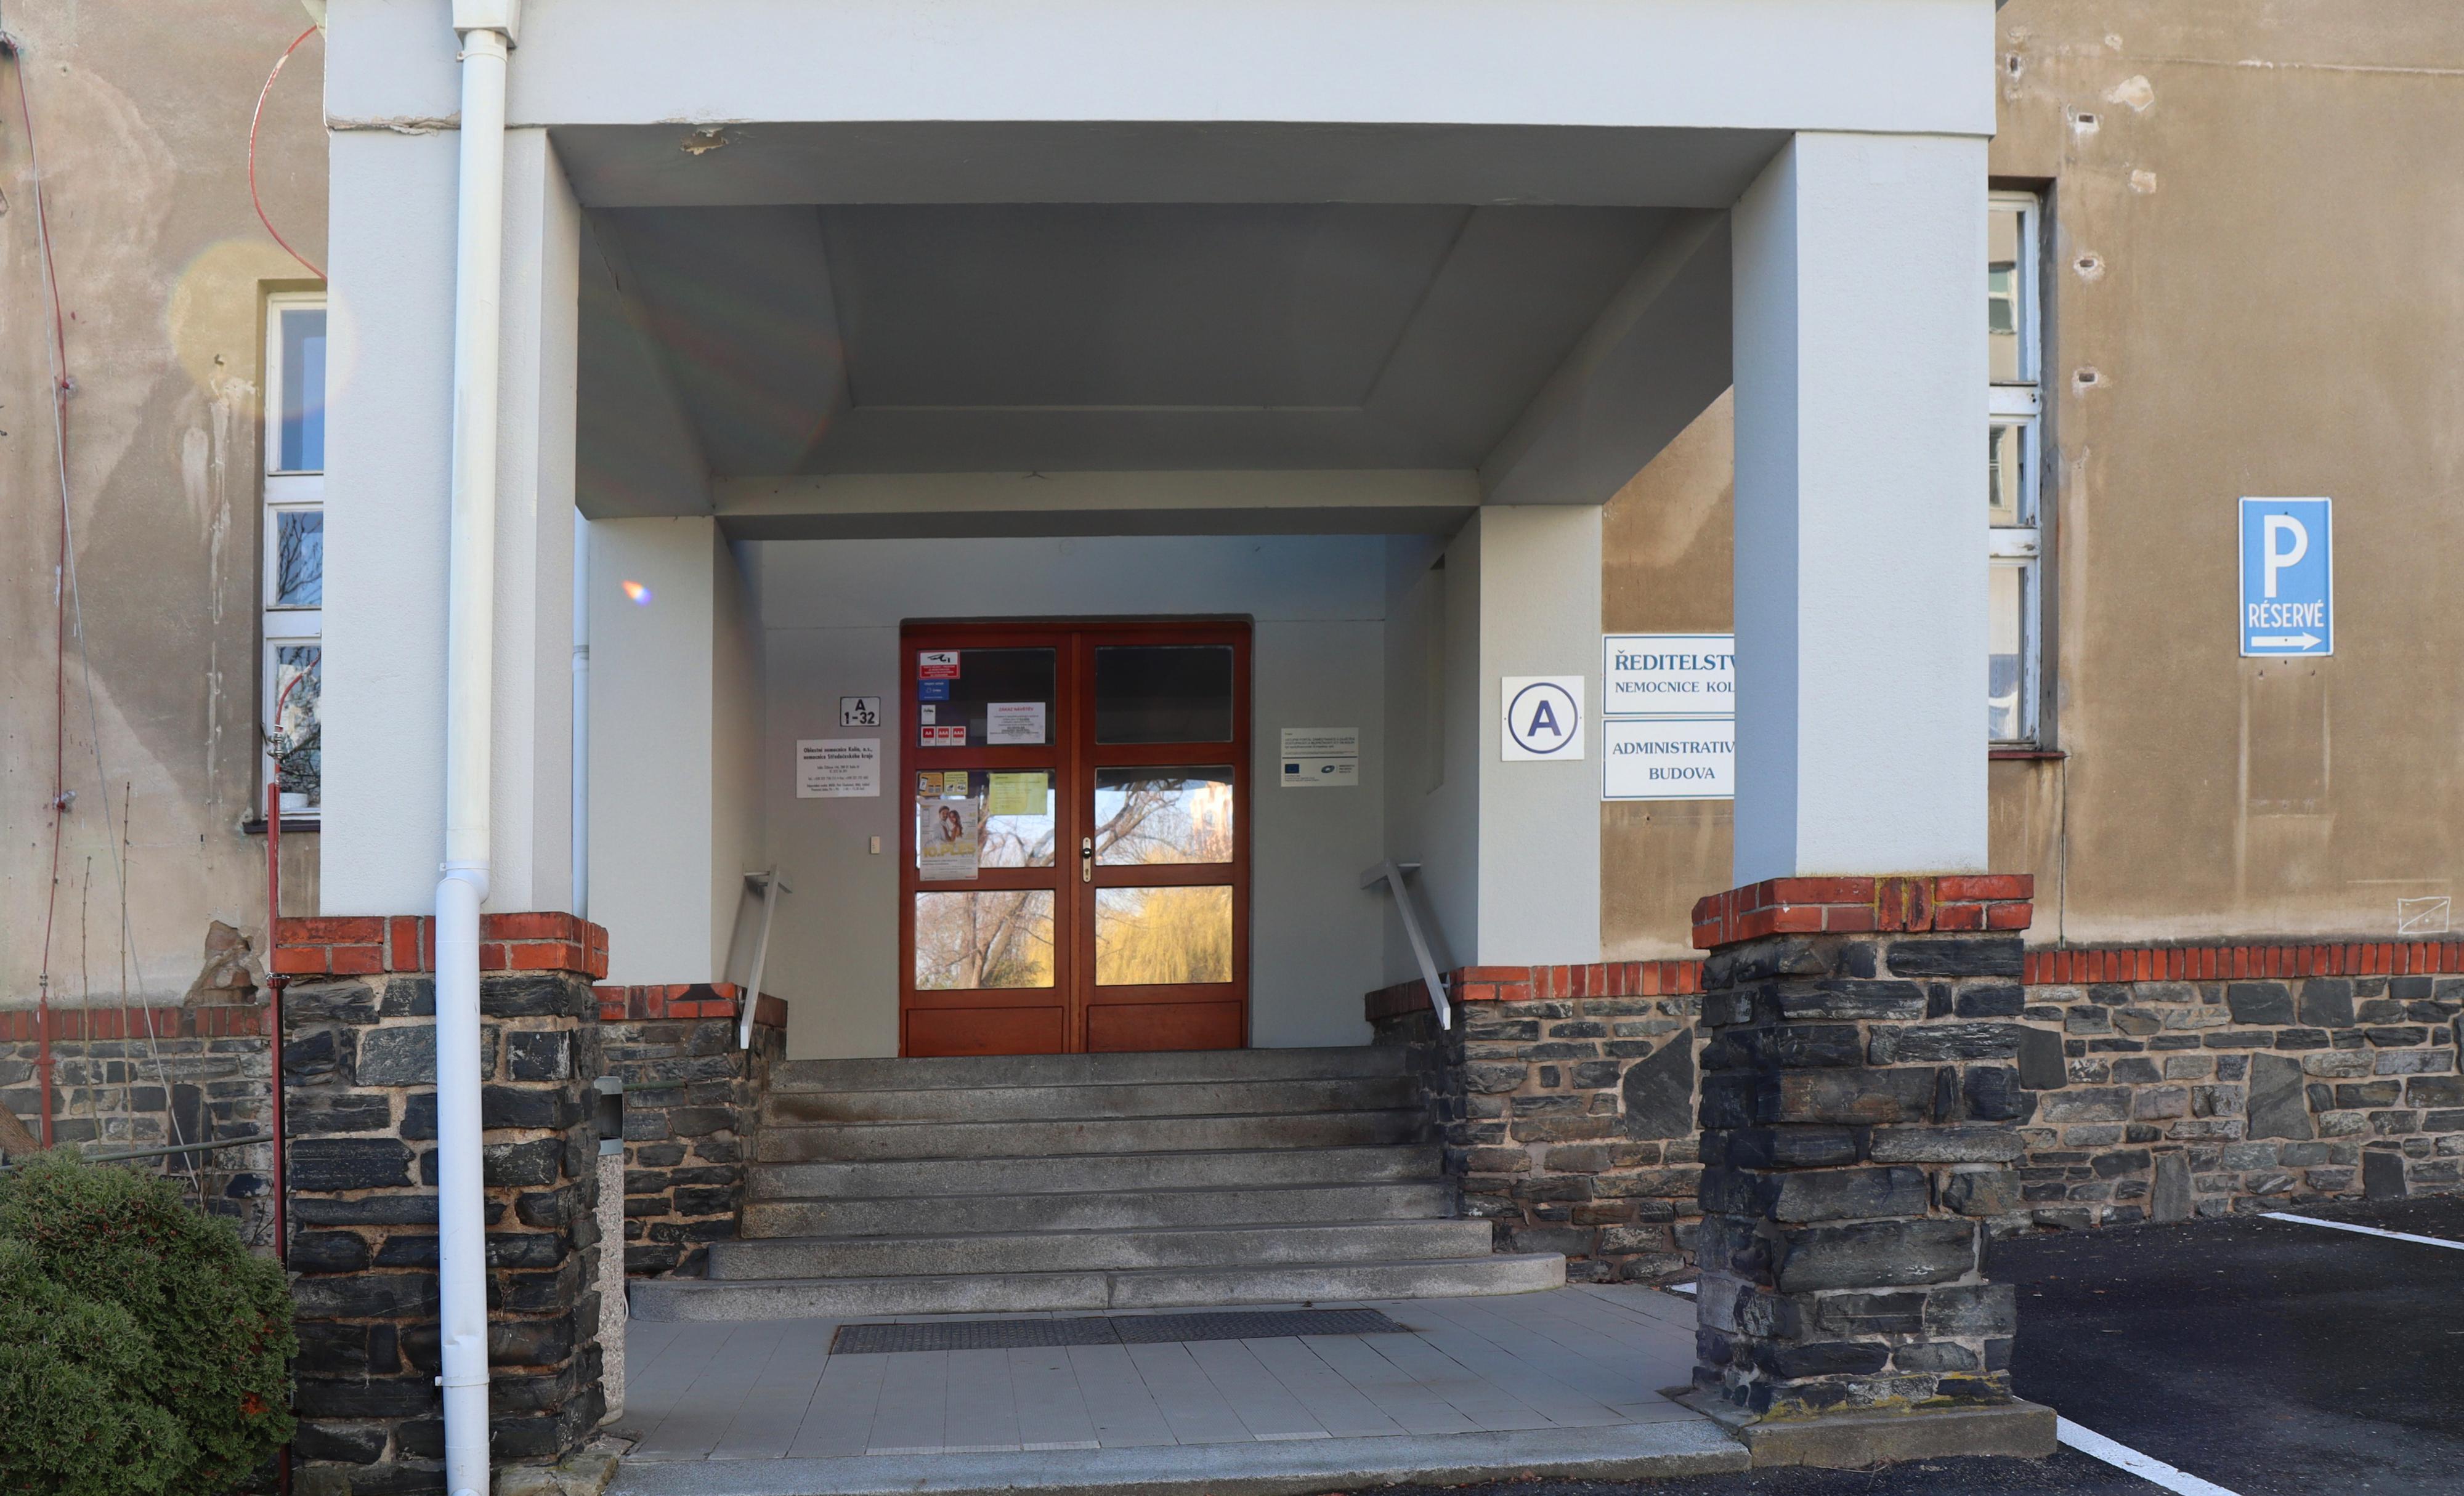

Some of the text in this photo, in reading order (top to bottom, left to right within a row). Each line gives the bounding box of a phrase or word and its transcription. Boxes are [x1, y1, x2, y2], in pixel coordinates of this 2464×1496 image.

[2264, 514, 2308, 598] P
[2248, 599, 2324, 628] RÉSERVÉ
[1615, 681, 1700, 693] NEMOCNICE
[855, 699, 865, 711] A
[845, 711, 875, 724] 1-32
[1527, 700, 1562, 737] A
[1648, 767, 1716, 780] BUDOVA
